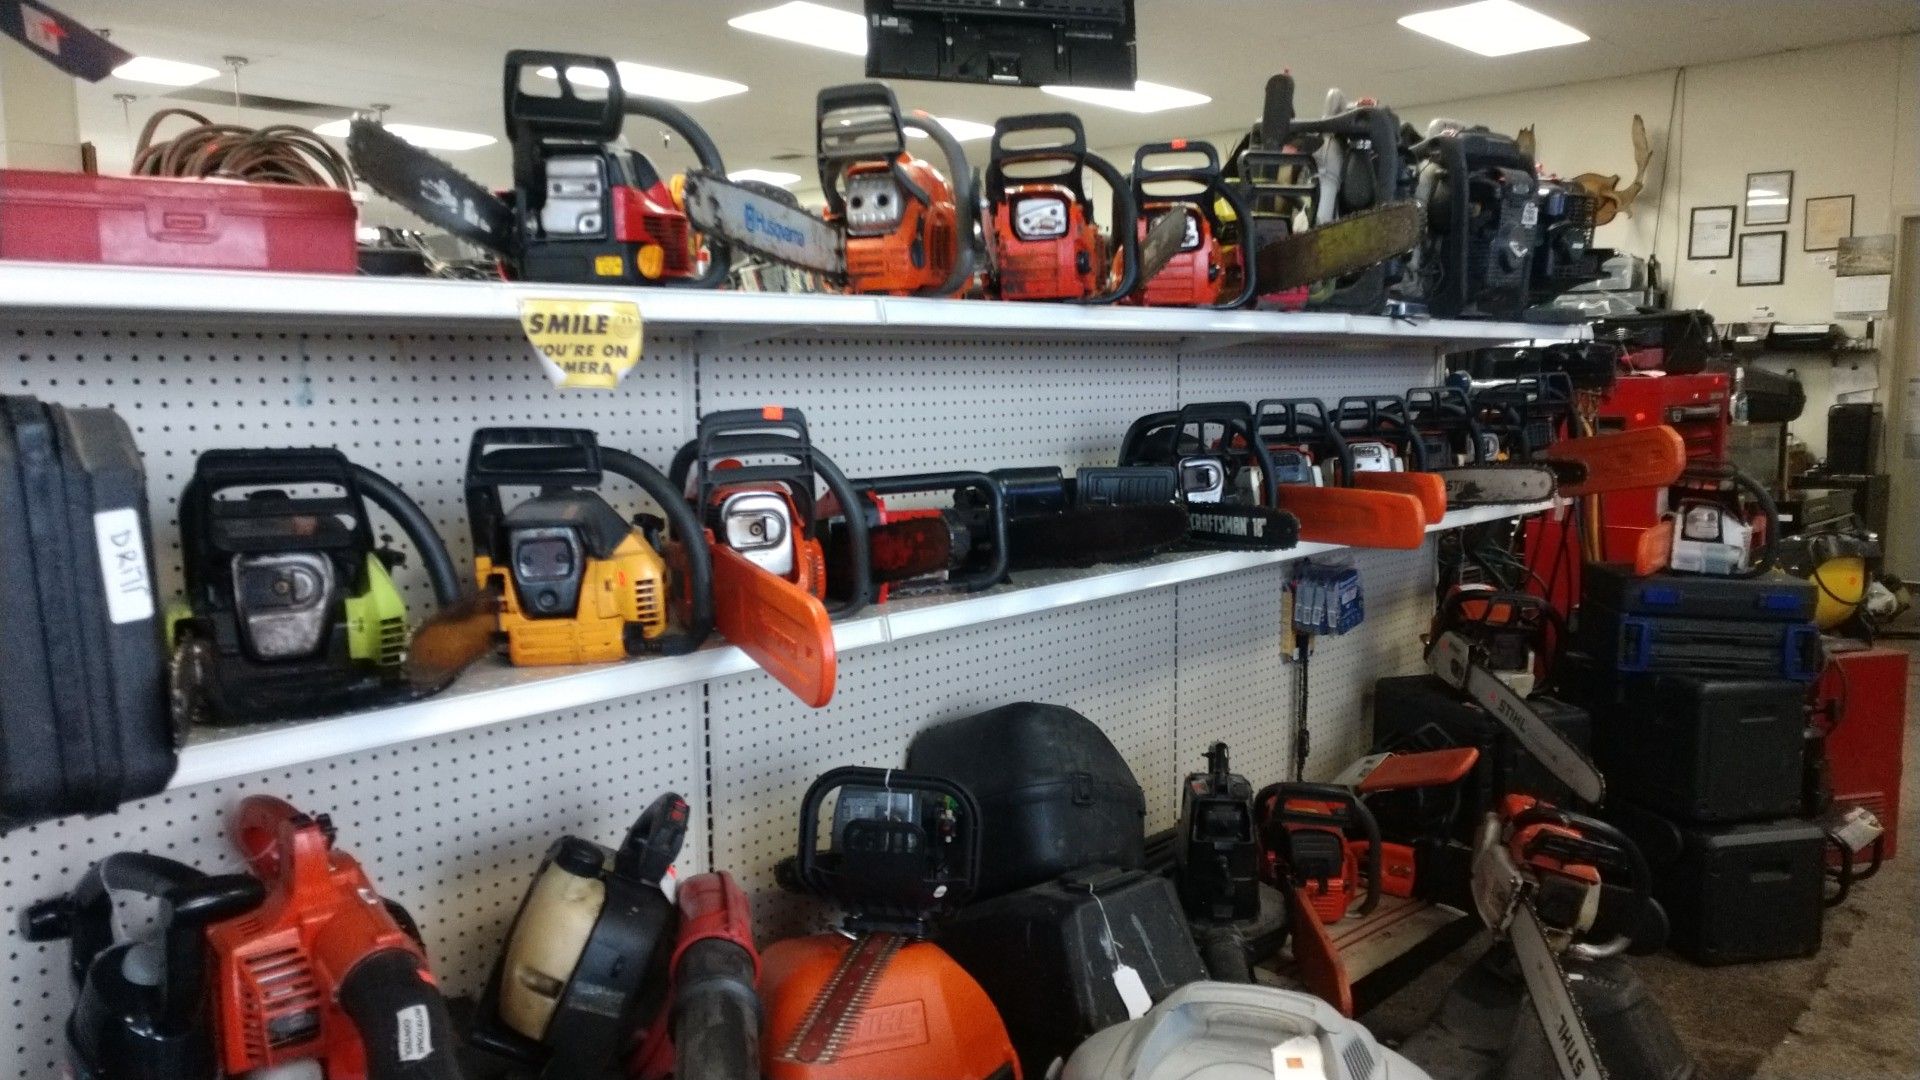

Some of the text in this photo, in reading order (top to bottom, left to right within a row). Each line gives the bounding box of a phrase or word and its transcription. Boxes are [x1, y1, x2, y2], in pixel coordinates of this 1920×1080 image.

[528, 313, 609, 335] SMILE
[602, 344, 629, 358] ON
[556, 361, 613, 375] MERA
[1188, 513, 1249, 537] CRAFTSMAN
[1497, 699, 1528, 734] STIHL
[1558, 1014, 1586, 1078] STIHL
